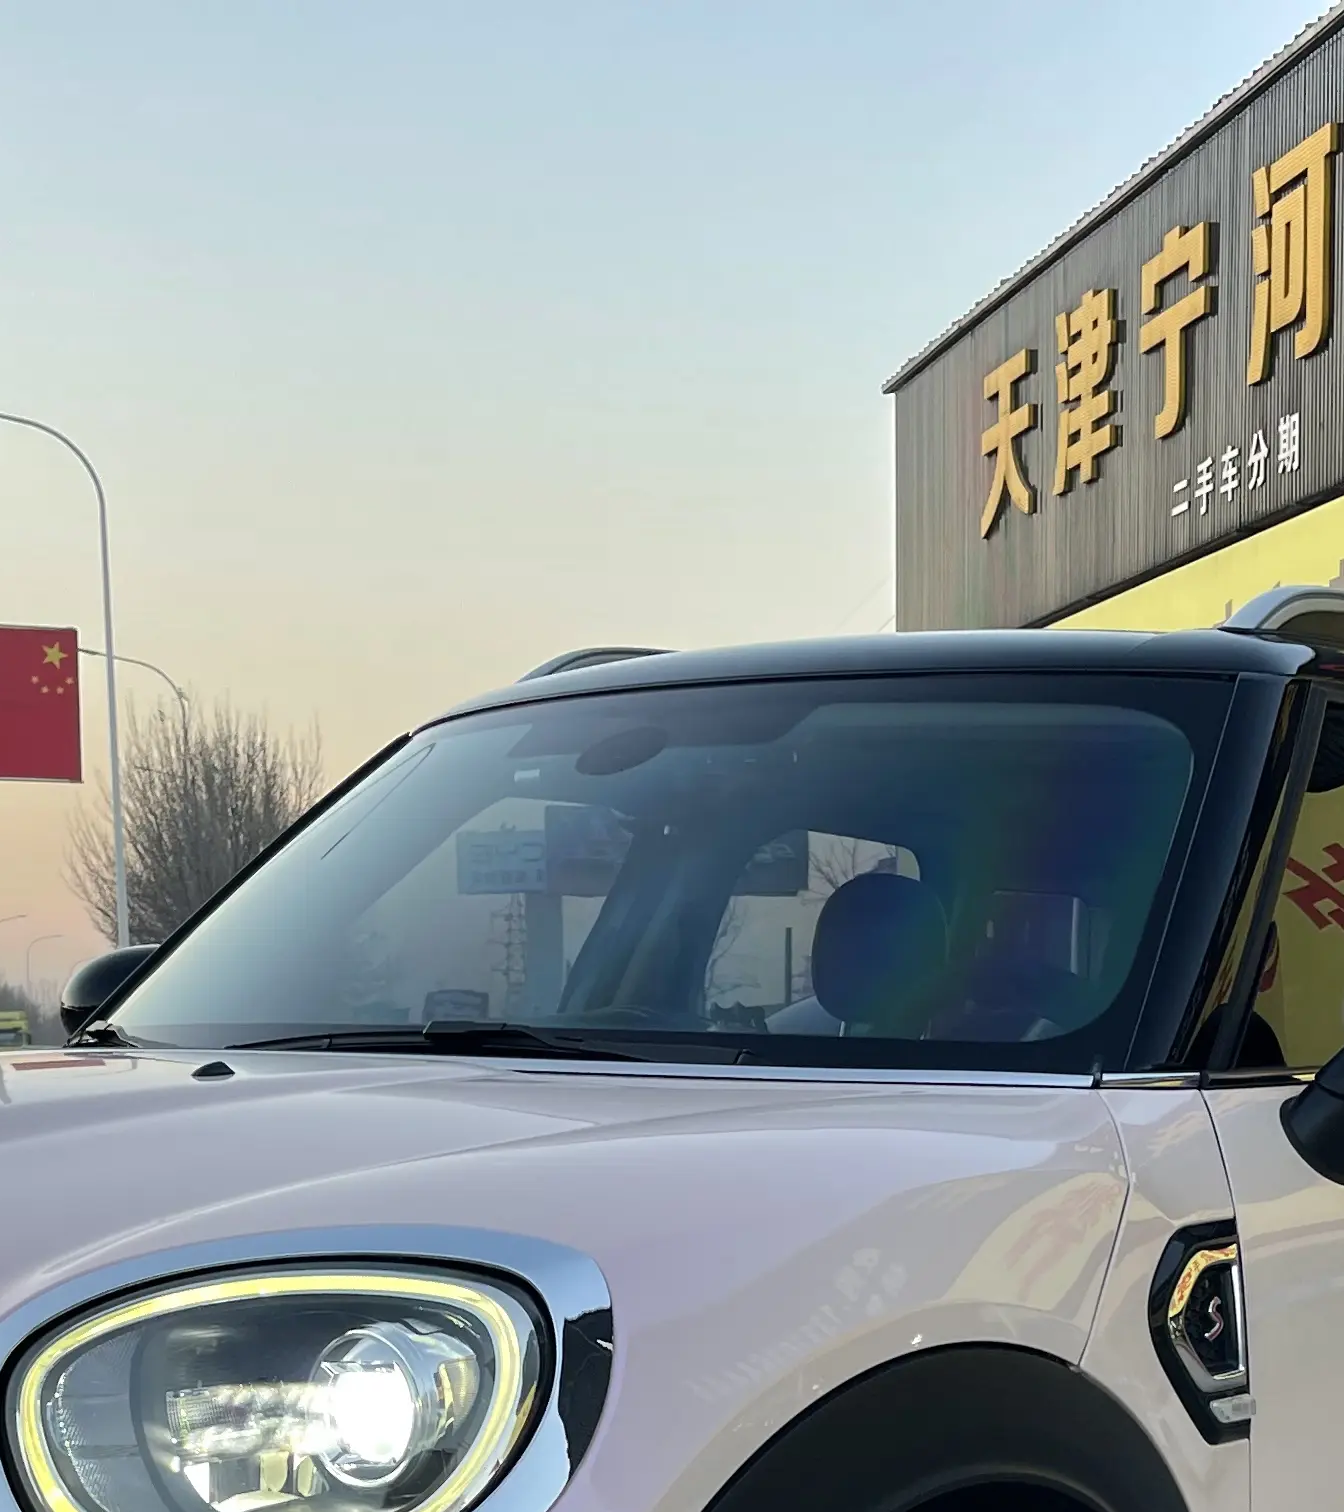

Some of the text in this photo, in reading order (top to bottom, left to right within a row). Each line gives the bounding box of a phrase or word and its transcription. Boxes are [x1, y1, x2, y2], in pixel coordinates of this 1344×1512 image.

[1170, 412, 1301, 517] 二手车分期
